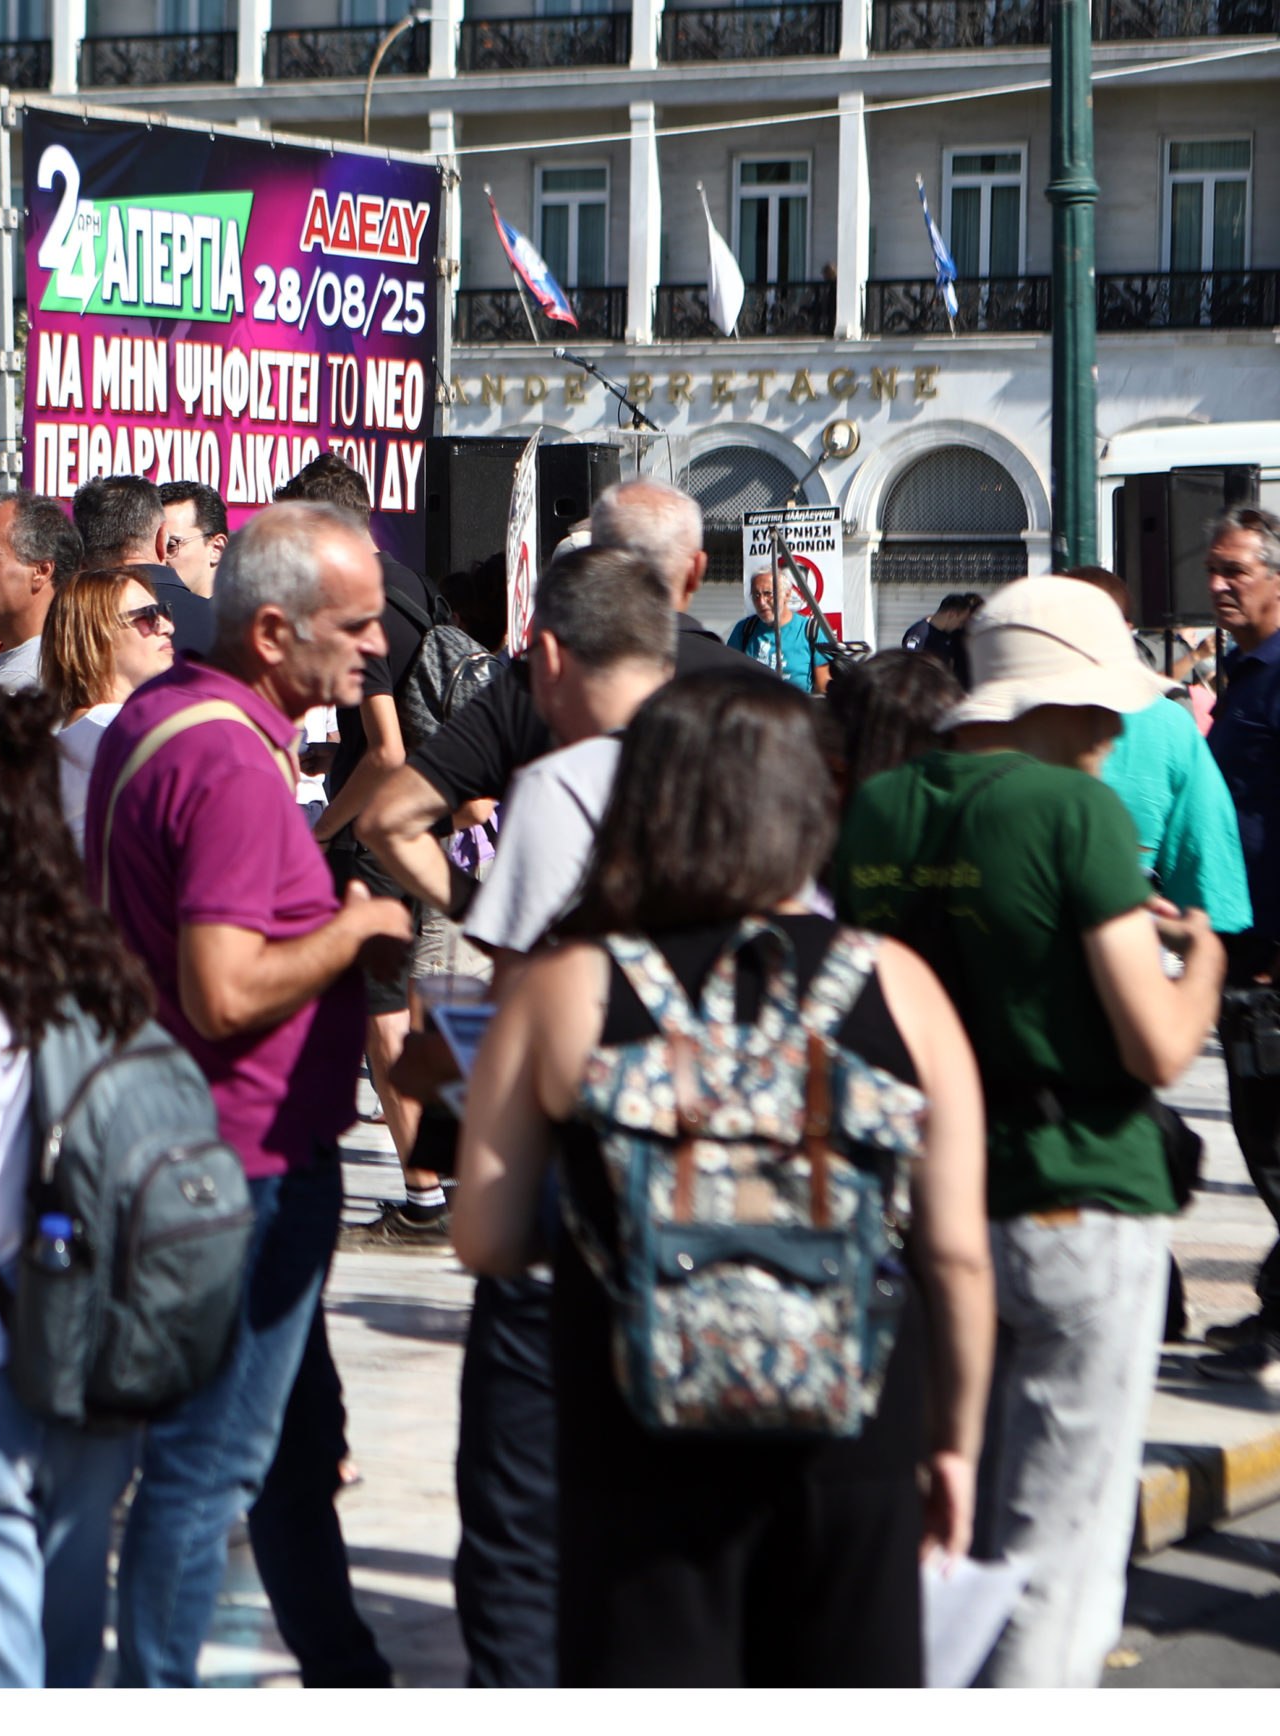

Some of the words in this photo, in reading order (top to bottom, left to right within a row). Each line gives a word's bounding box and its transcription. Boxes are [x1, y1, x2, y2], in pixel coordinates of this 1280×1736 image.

[102, 206, 245, 314] ΑΠΕΡΓΙΑ
[301, 190, 429, 263] ΑΔΕΔΥ
[253, 264, 425, 334] 28/08/25
[35, 331, 82, 408] ΝΑ
[91, 336, 168, 413] ΜΗΝ
[176, 341, 320, 424] ΨΗΦΙΣΤΕΙ
[327, 354, 358, 428] ΤΟ
[365, 358, 424, 432] ΝΕΟ
[627, 365, 941, 405] BRETAGNE
[381, 440, 424, 511] ΔΥ
[749, 539, 835, 556] ΔΟΛΦΟΝΩΝ
[752, 525, 832, 542] ΚΥΕΡΝΗΣΗ
